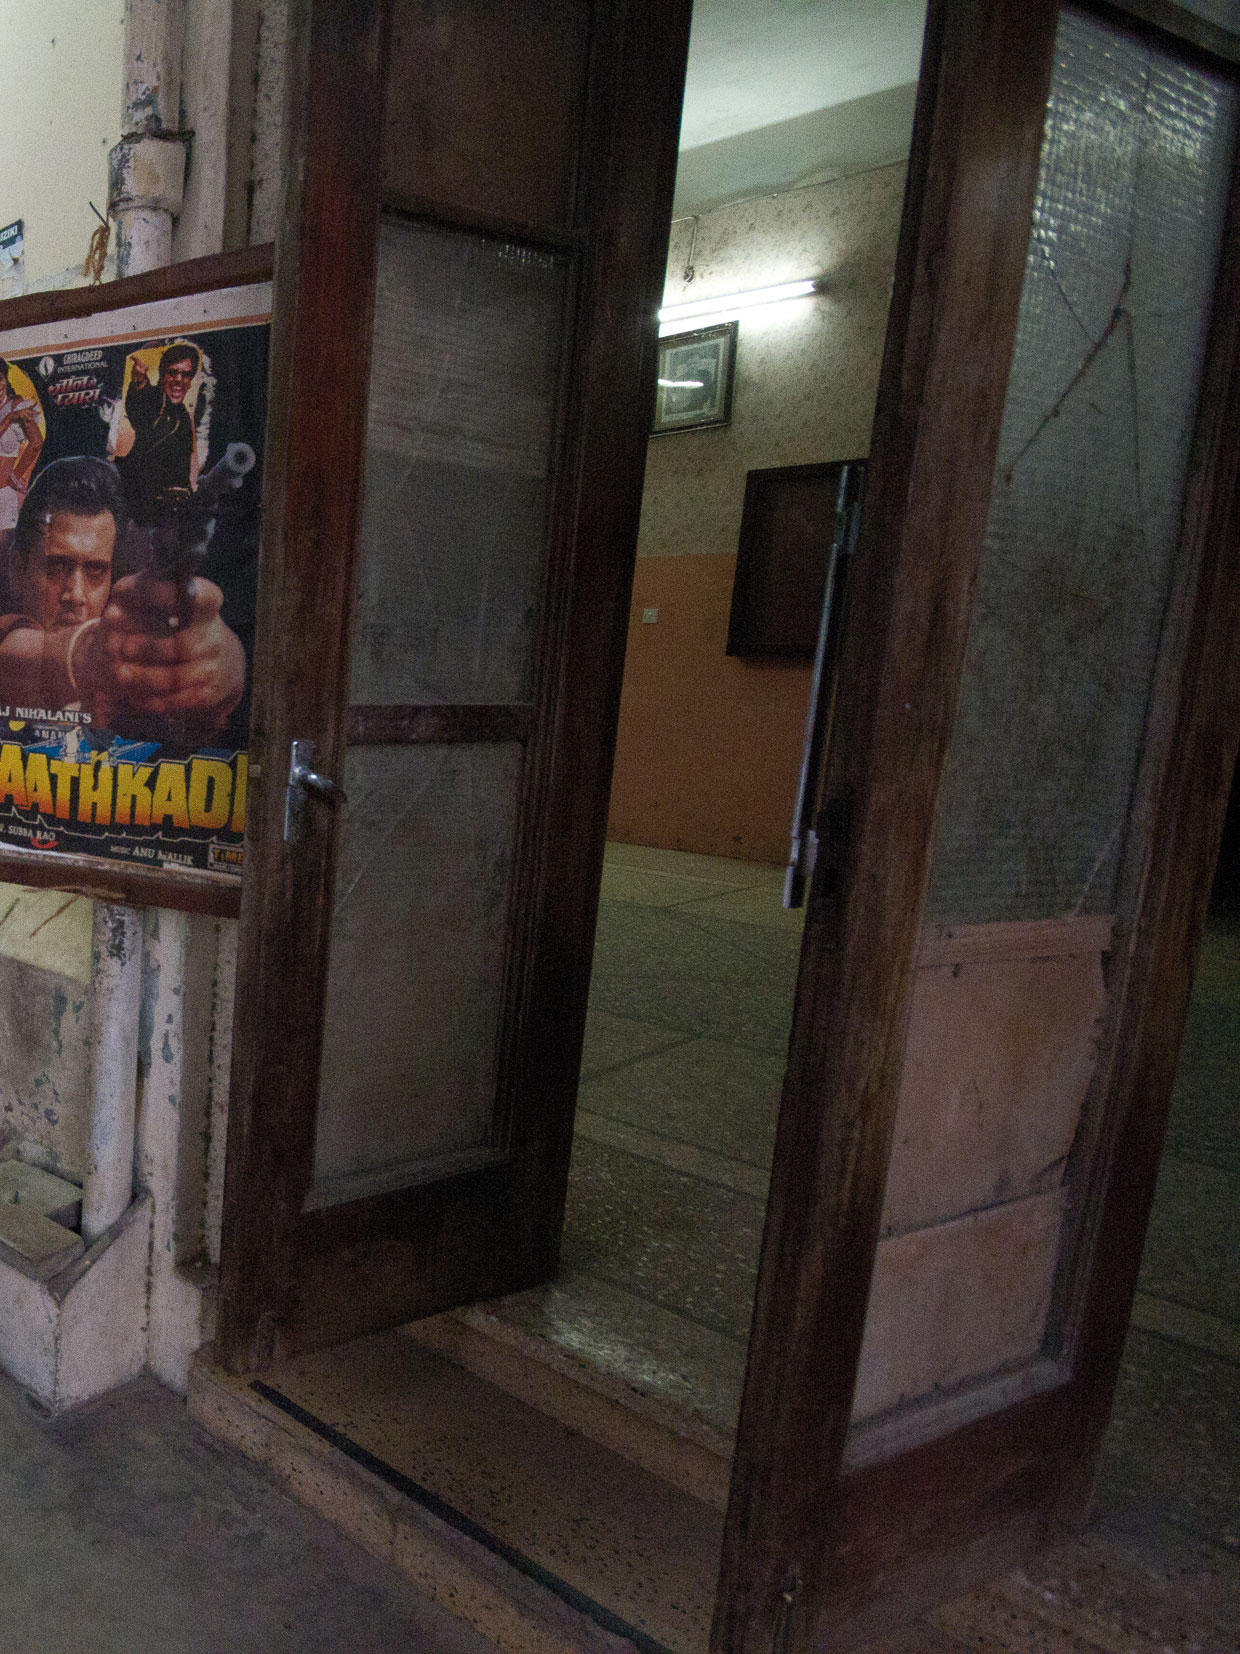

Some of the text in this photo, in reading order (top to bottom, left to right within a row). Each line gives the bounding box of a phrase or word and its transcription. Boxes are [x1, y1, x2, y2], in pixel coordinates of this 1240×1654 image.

[57, 361, 109, 374] INTERNATIONAL
[15, 707, 92, 724] NIHALANI'S
[8, 824, 33, 838] SUBBA
[35, 830, 56, 842] RAO
[133, 846, 155, 859] ANU
